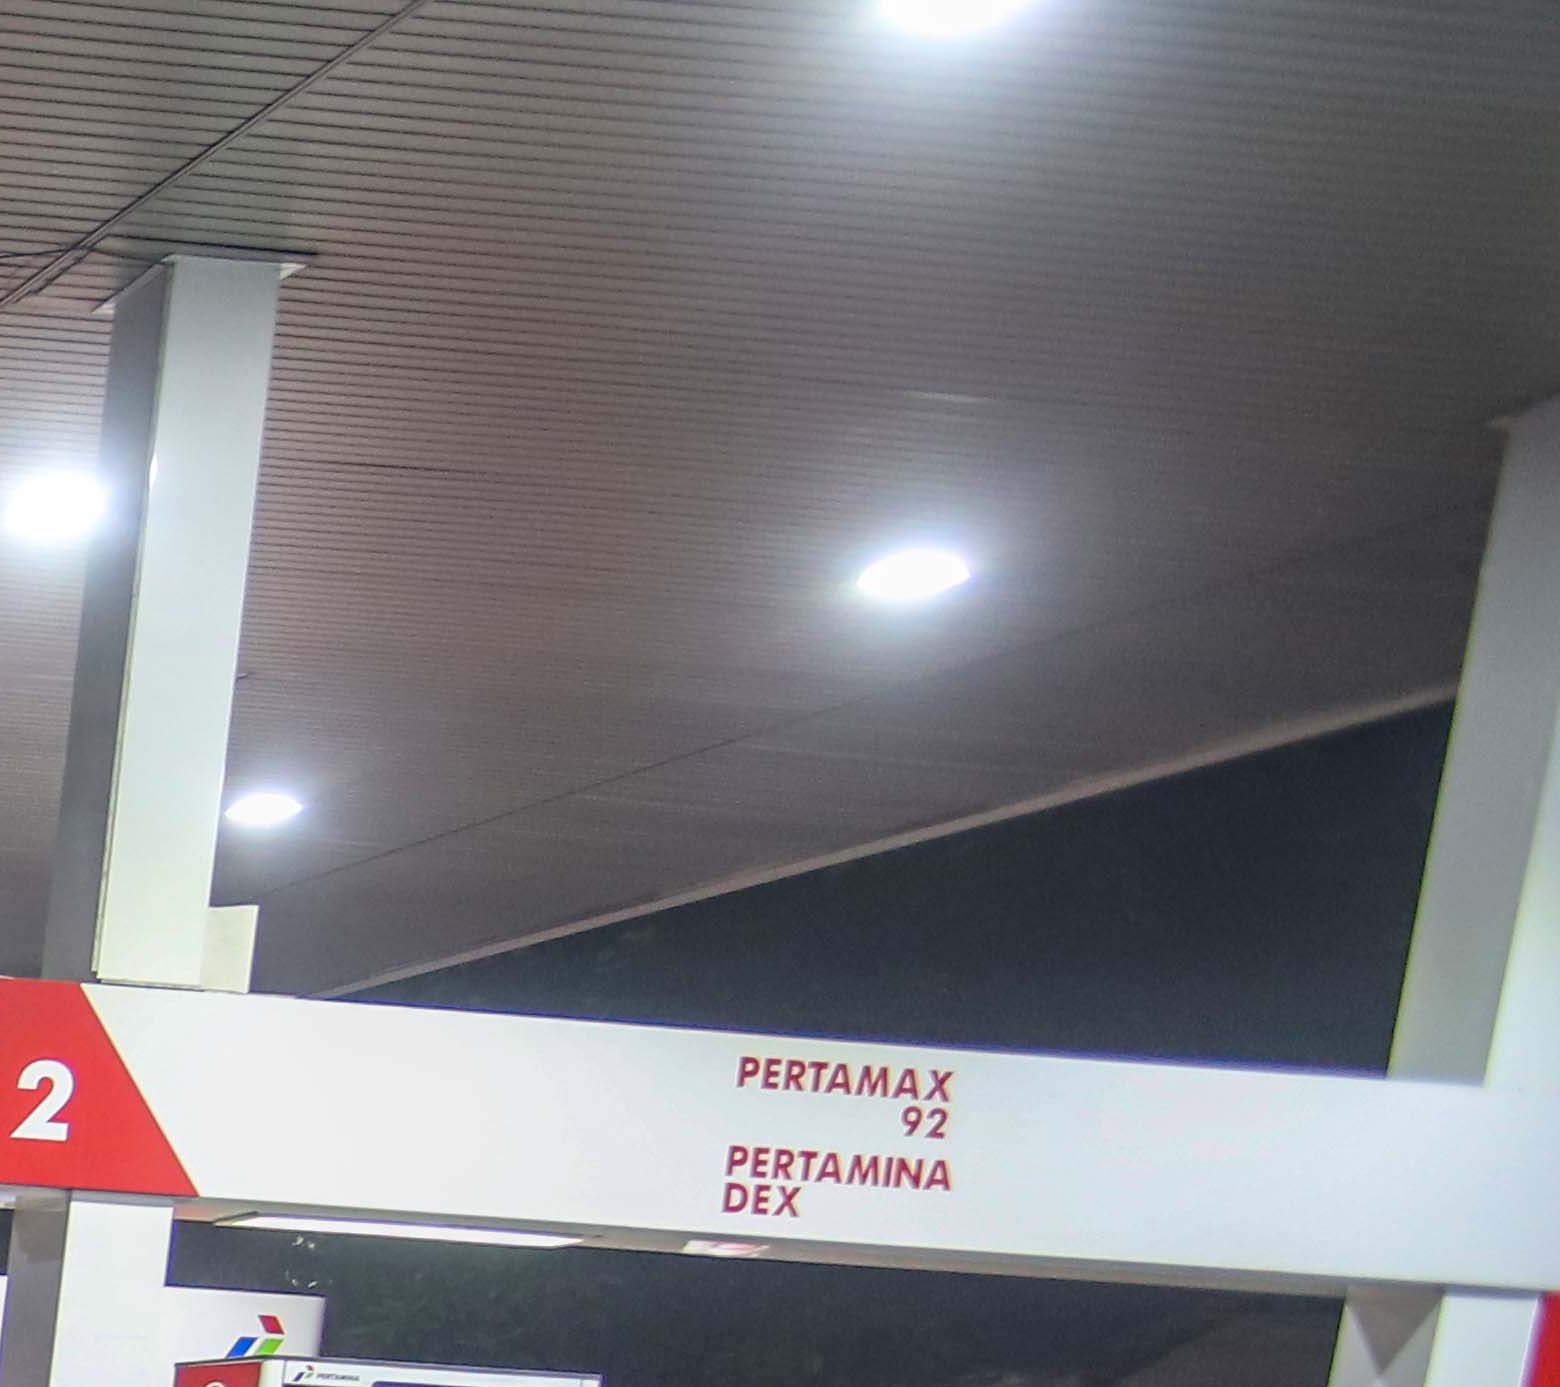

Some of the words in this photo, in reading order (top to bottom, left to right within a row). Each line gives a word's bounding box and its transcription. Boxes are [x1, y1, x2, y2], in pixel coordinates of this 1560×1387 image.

[9, 1058, 75, 1141] 2
[736, 1056, 954, 1102] PERTAMAX
[900, 1106, 949, 1140] 92
[725, 1145, 952, 1192] PERTAMINA
[722, 1183, 802, 1219] DEX
